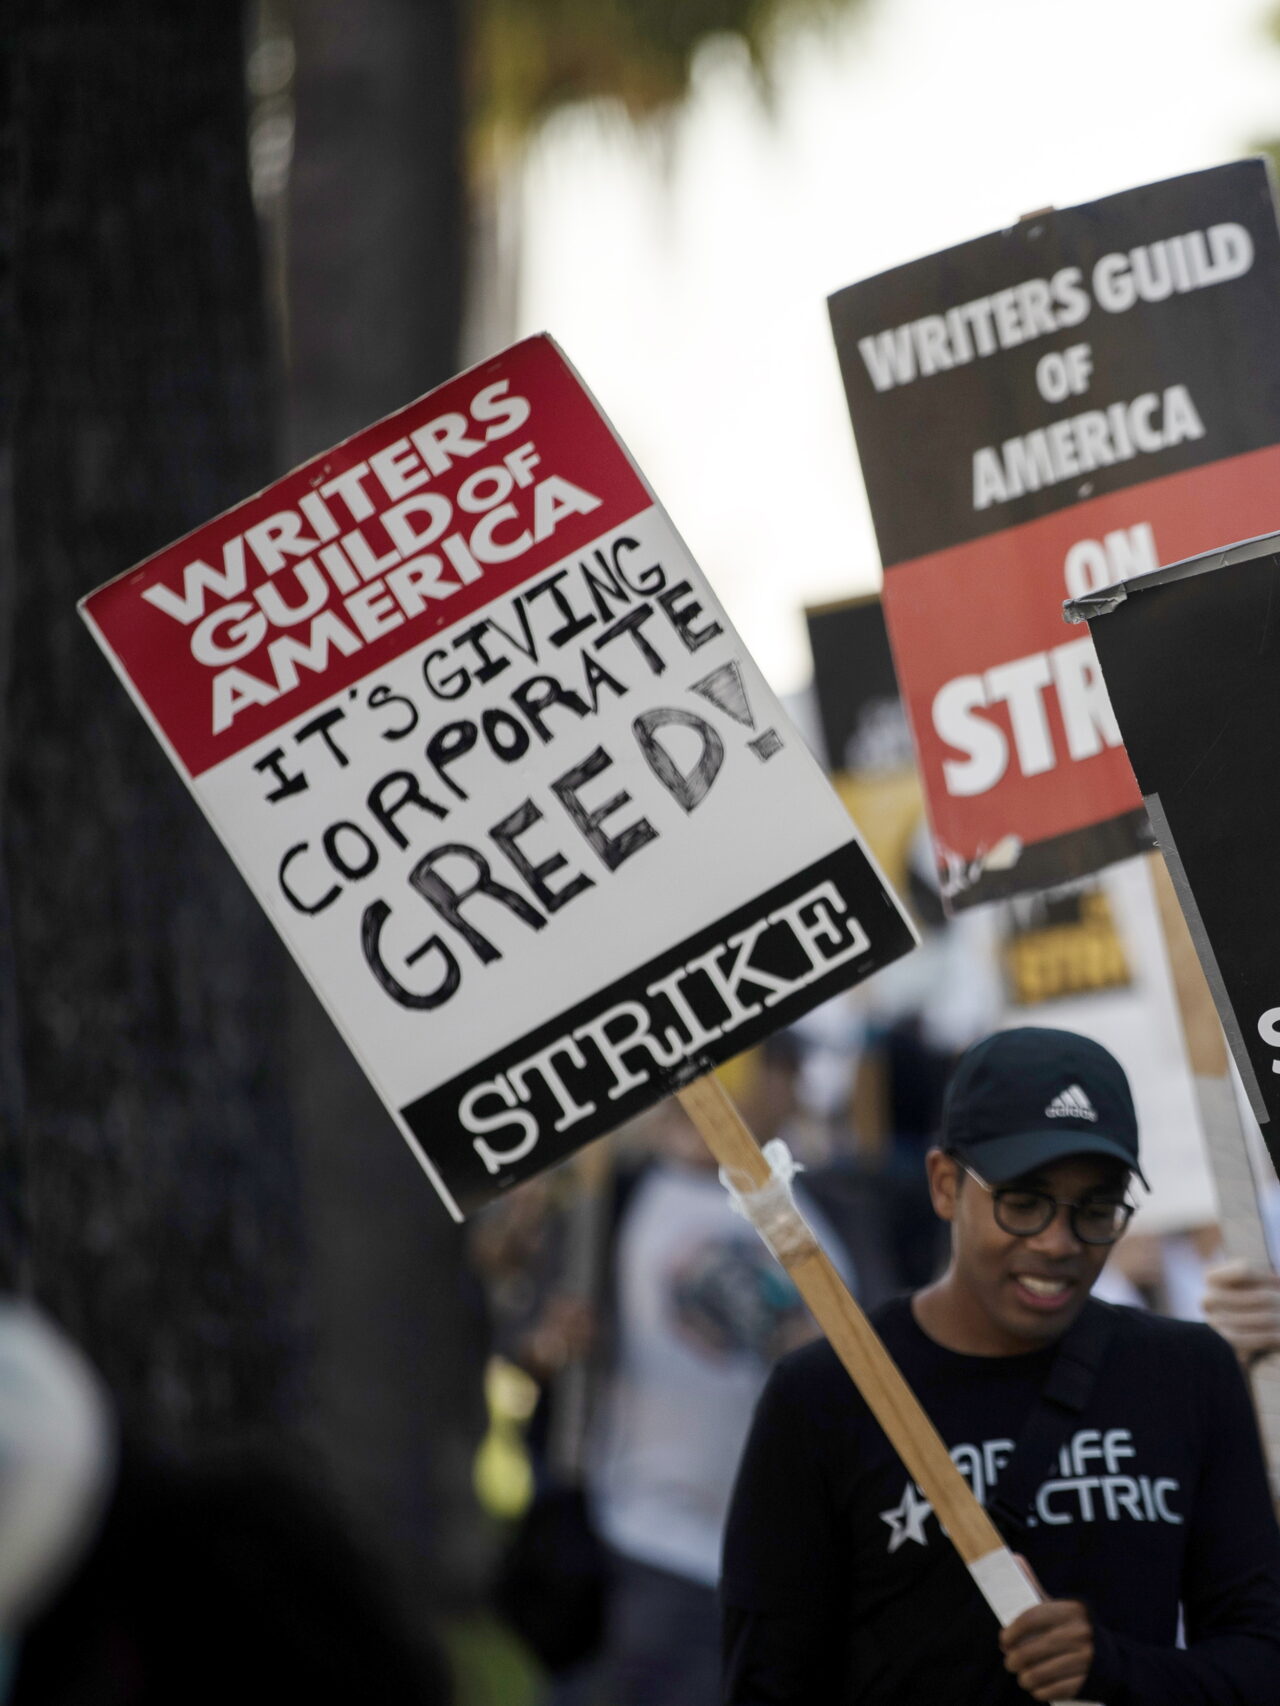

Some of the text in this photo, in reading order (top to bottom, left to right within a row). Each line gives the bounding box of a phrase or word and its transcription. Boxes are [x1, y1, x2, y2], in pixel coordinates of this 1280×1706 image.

[859, 222, 1254, 393] WRITERS GUILD
[1036, 344, 1092, 402] OF
[143, 380, 531, 626] WRITERS
[190, 443, 542, 667] GUILD OF
[972, 385, 1205, 511] AMERICA
[211, 476, 602, 736] AMERICA
[254, 536, 671, 803] IT'S GIVING
[1064, 523, 1159, 600] ON
[277, 580, 725, 916] CORPORATE
[932, 637, 1124, 796] STR
[360, 660, 784, 1011] GREED!
[458, 880, 870, 1174] STRIKE
[1045, 1105, 1098, 1122] adidas
